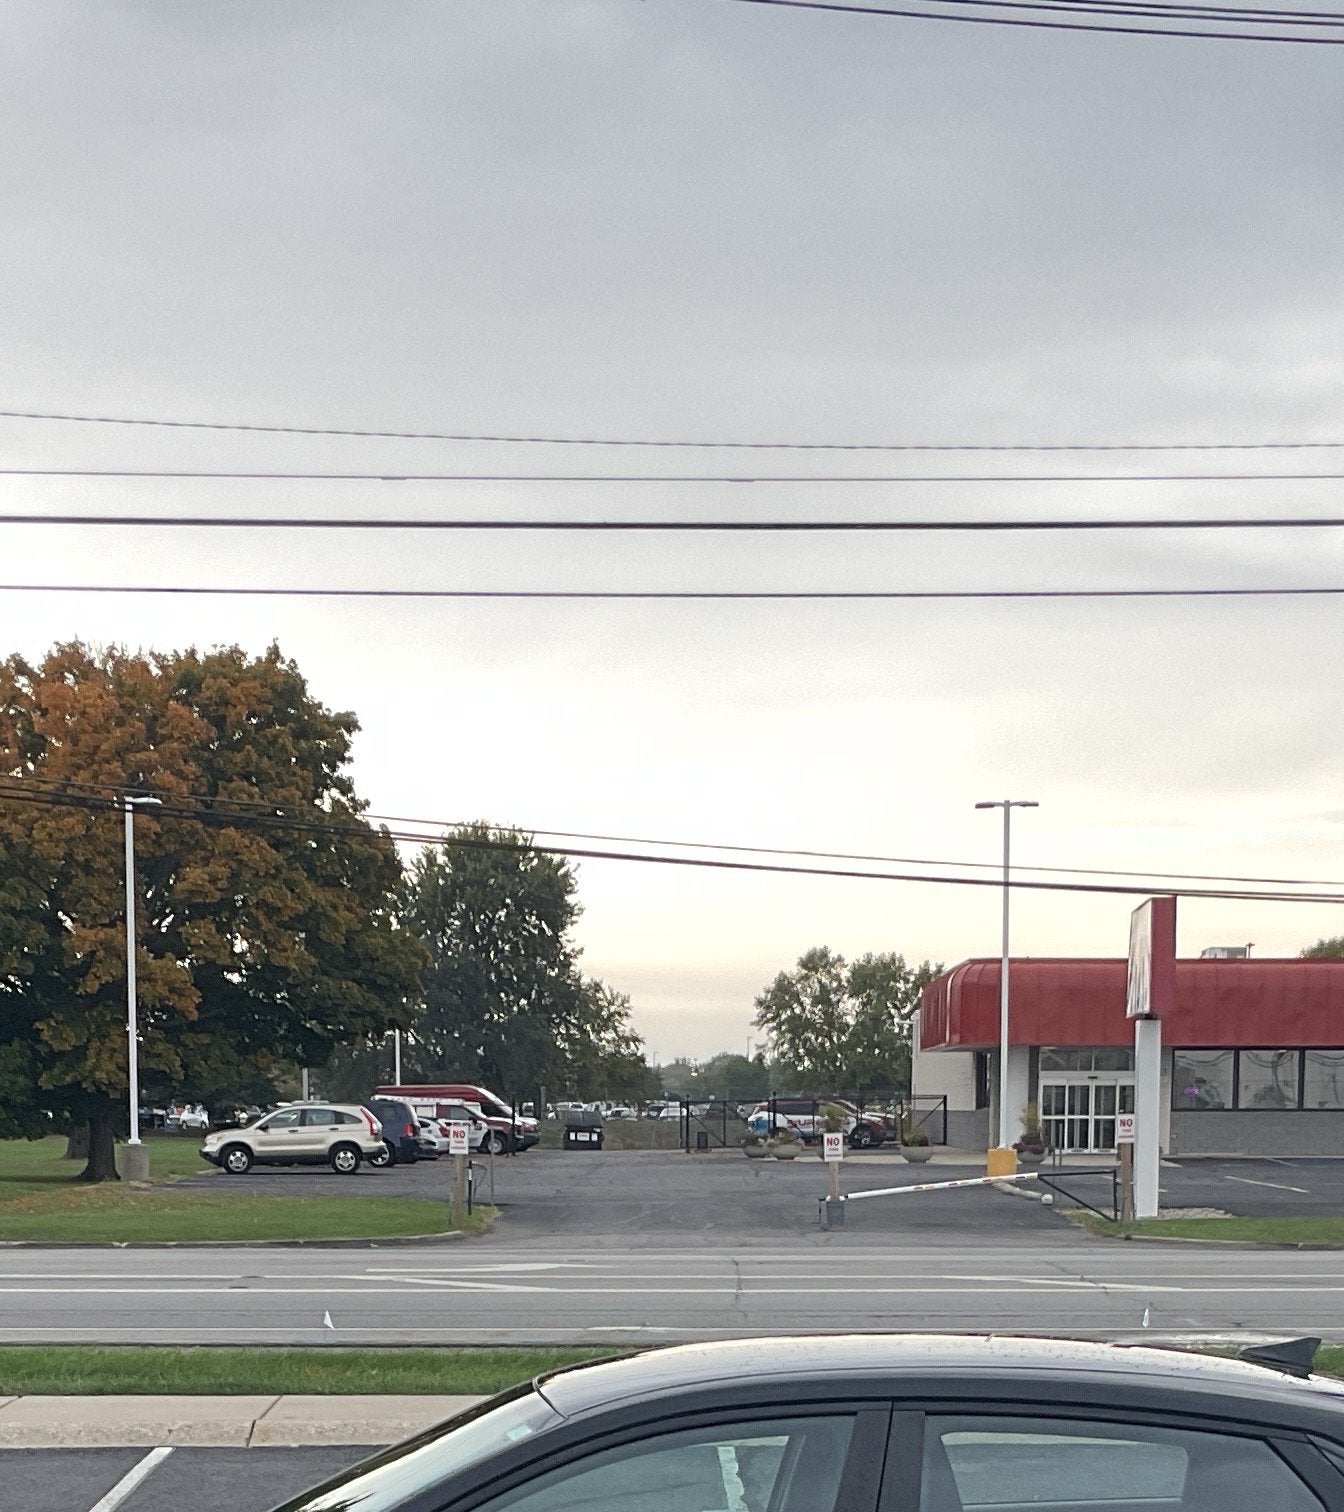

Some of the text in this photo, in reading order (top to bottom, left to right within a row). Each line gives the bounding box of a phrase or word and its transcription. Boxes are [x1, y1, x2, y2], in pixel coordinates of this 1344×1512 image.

[1119, 1118, 1133, 1127] NO
[452, 1130, 466, 1139] NO
[826, 1137, 840, 1146] NO
